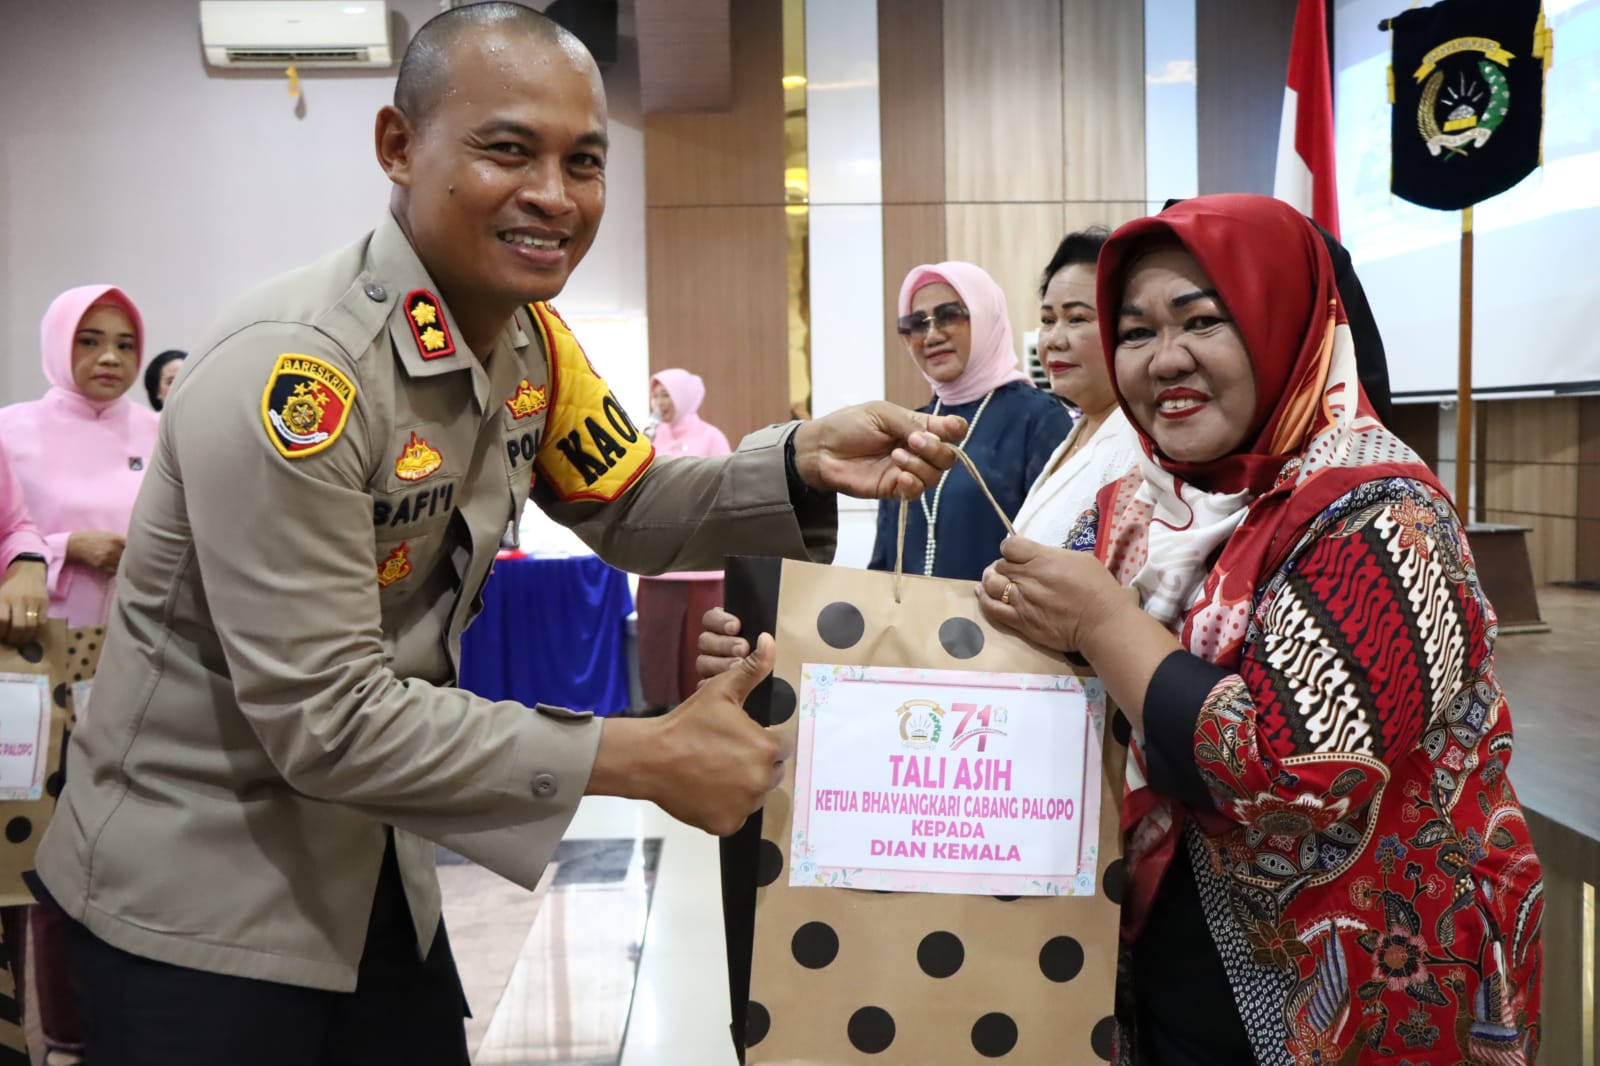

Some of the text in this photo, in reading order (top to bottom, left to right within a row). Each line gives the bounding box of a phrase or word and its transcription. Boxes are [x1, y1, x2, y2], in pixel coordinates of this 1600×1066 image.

[283, 360, 351, 396] BARESKRIM
[950, 703, 994, 752] 71
[889, 755, 1012, 791] TALI ASIH
[815, 789, 1074, 820] KETUA BHAYANGKARI CABANG PALOPO
[911, 819, 985, 839] KEPADA
[870, 839, 1021, 862] DIAN KEMALA
